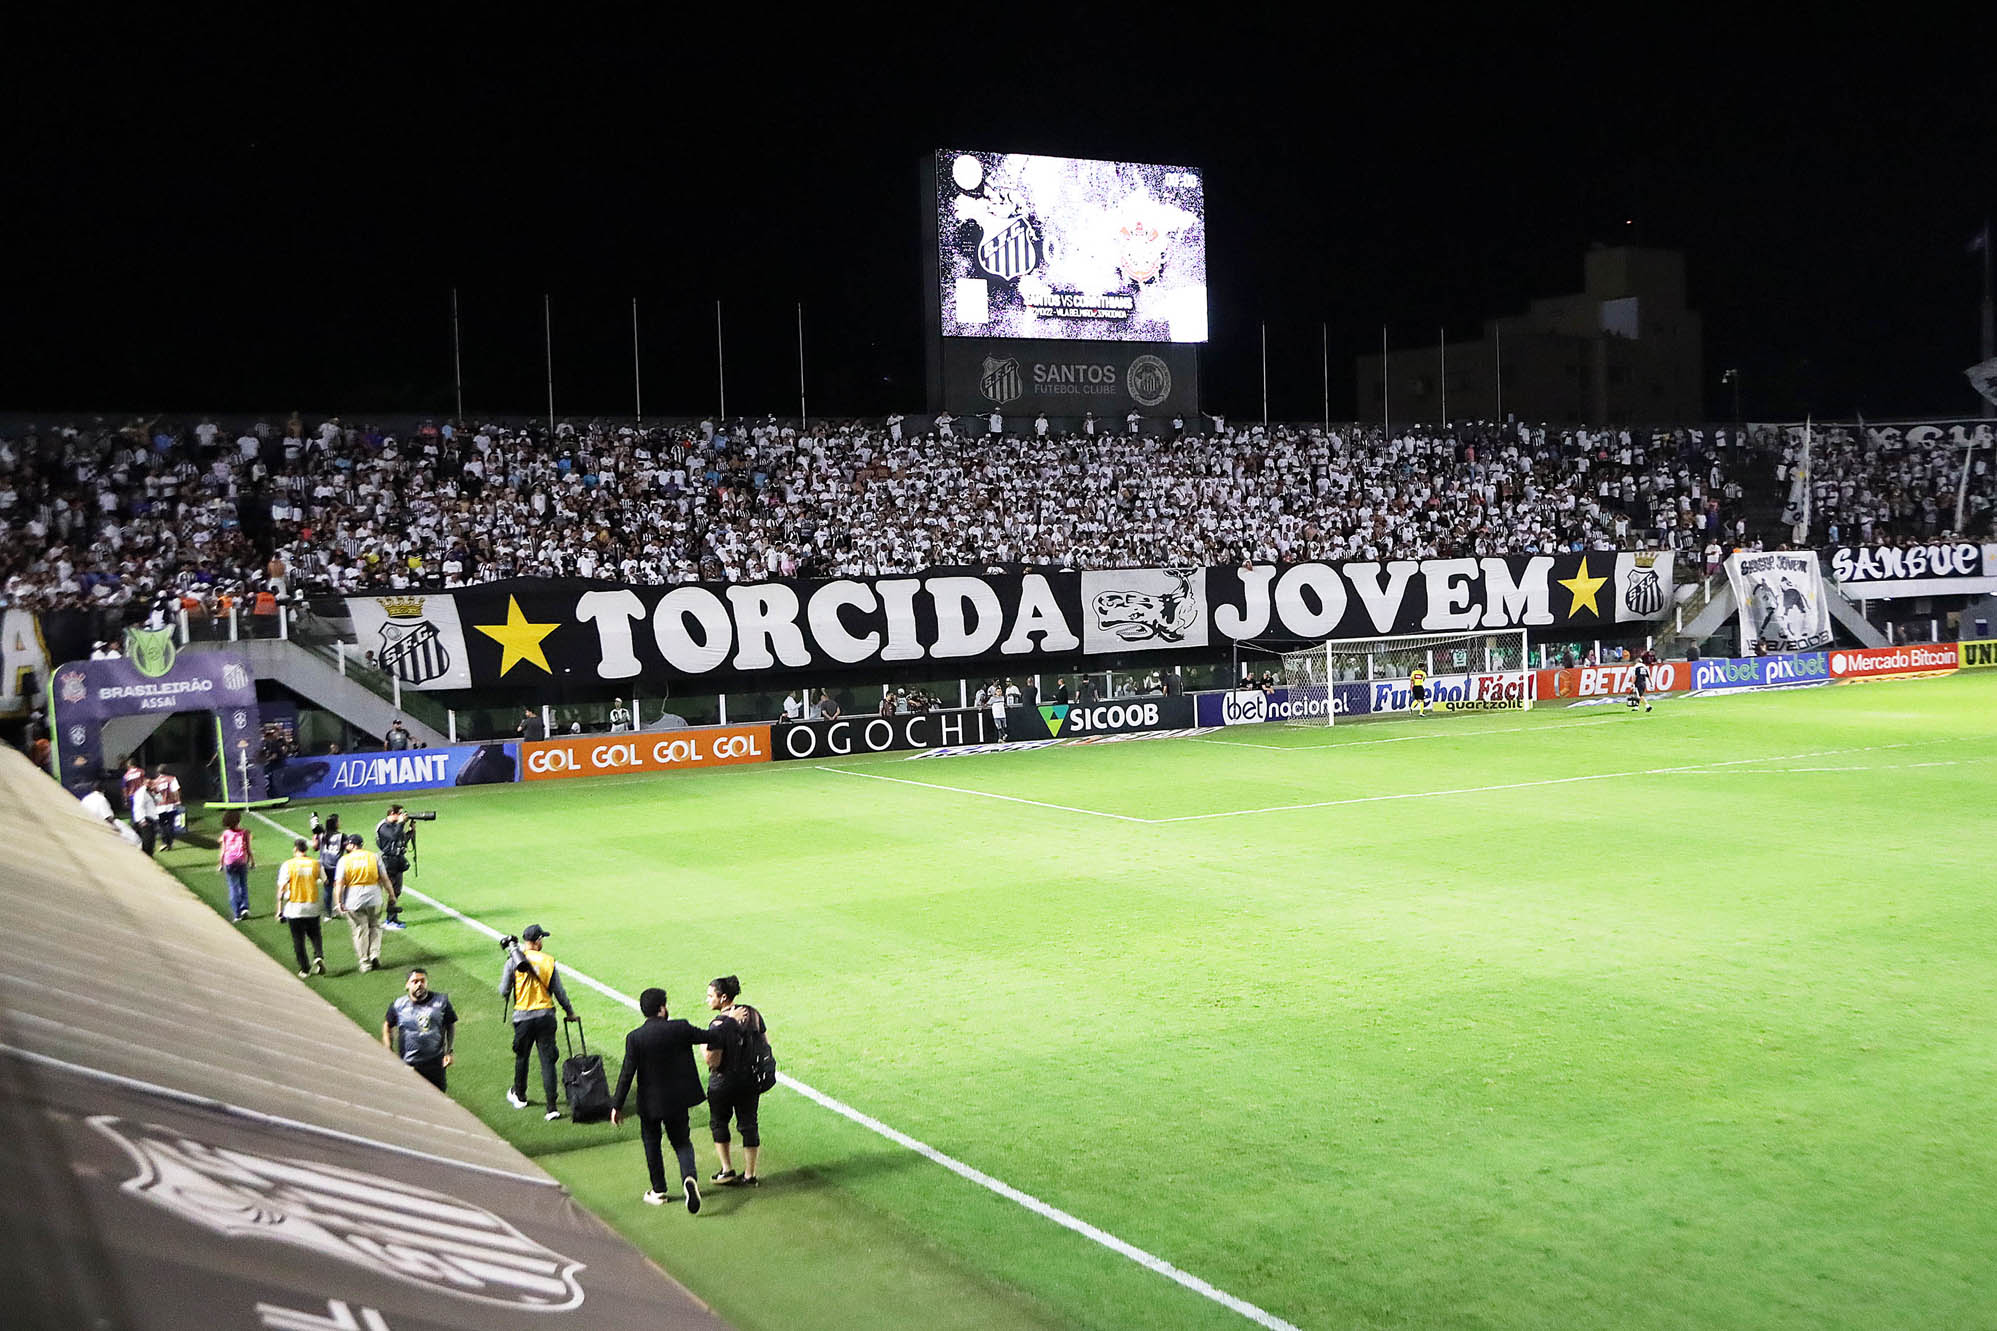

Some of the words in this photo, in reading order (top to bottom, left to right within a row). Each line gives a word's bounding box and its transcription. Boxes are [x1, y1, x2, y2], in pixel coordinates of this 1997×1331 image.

[1060, 295, 1074, 308] VS
[1033, 363, 1116, 384] SANTOS
[1034, 385, 1081, 395] FUTEBOL
[1083, 385, 1117, 395] CLUBE
[1831, 543, 1979, 582] SANGUE
[576, 574, 1080, 679] TORCIDA
[1214, 557, 1555, 640] JOVEM
[384, 626, 433, 666] S.F.C.
[1747, 630, 1830, 652] 198/2008
[1697, 657, 1760, 690] pixbet
[1766, 651, 1826, 684] pixbet
[1848, 650, 1909, 672] Mercado
[1911, 646, 1956, 667] Bitcoin
[100, 678, 213, 700] BRASILEIRÃO
[1373, 678, 1473, 712] Fuebol
[1477, 673, 1535, 701] Fácil
[1069, 704, 1159, 731] SICOOB
[1446, 699, 1523, 711] quartzolit
[528, 749, 581, 773] GOL
[592, 744, 643, 768] GOL
[653, 739, 703, 763] GOL
[713, 735, 761, 758] GOL
[332, 754, 449, 789] ADAMANT
